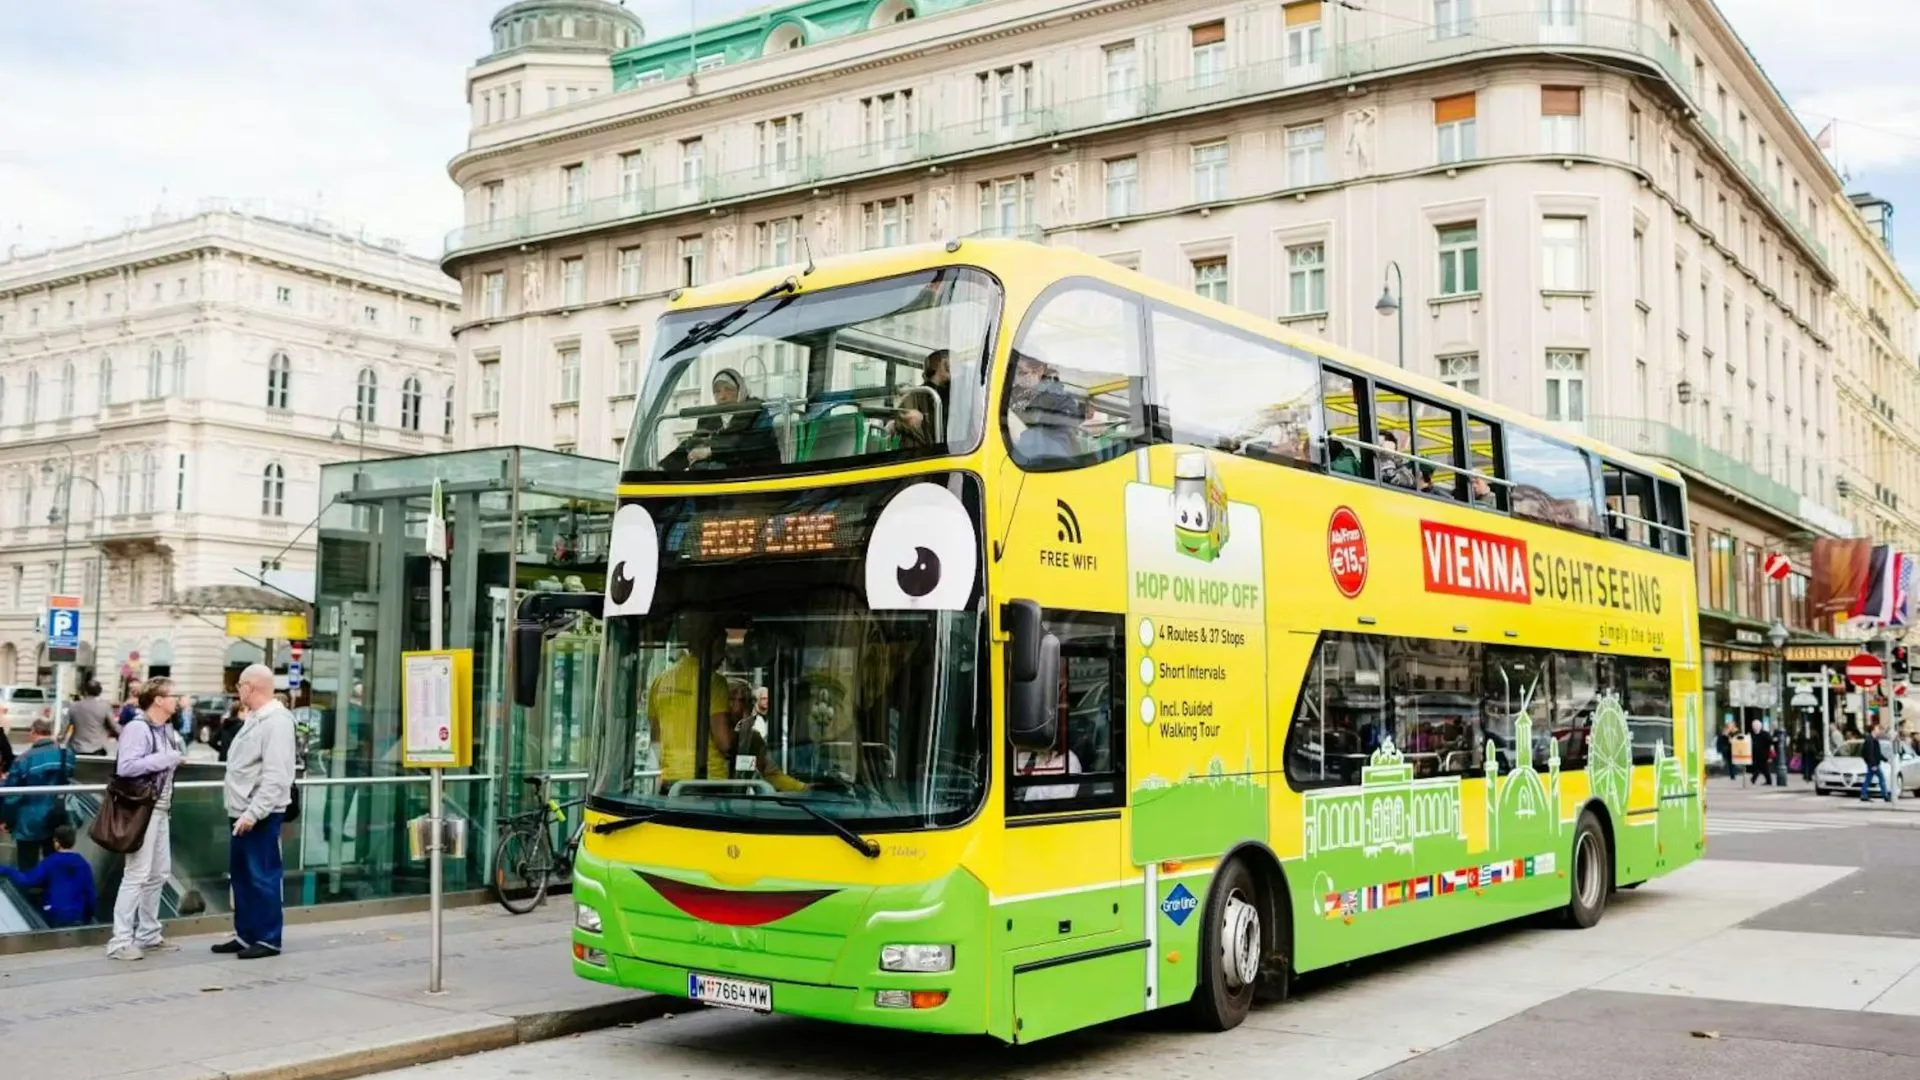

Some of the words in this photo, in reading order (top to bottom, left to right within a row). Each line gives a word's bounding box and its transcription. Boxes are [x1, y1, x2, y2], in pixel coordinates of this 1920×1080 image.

[701, 519, 755, 555] RED
[766, 514, 835, 552] LINE
[1040, 549, 1069, 568] FREE
[1072, 553, 1097, 571] WIFI
[1424, 530, 1527, 596] VIENNA
[1533, 551, 1661, 615] SIGHTSEEING
[1136, 571, 1169, 600] HOP
[1173, 576, 1195, 604] ON
[1199, 577, 1229, 606] HOP
[1232, 583, 1258, 609] OFF
[1159, 624, 1165, 640] 4
[1167, 625, 1198, 643] Routes
[1200, 627, 1207, 643] &
[1209, 628, 1219, 643] 37
[1221, 629, 1245, 648] Stops
[1600, 621, 1628, 646] simply
[1647, 625, 1664, 645] best
[1160, 661, 1185, 679] Short
[1187, 663, 1226, 680] Intervals
[1160, 700, 1180, 717] Incl.
[1182, 700, 1213, 717] Guided
[1160, 722, 1197, 741] Walking
[1200, 721, 1220, 738] Tour
[715, 981, 746, 1002] 7664
[750, 986, 767, 1005] MW
